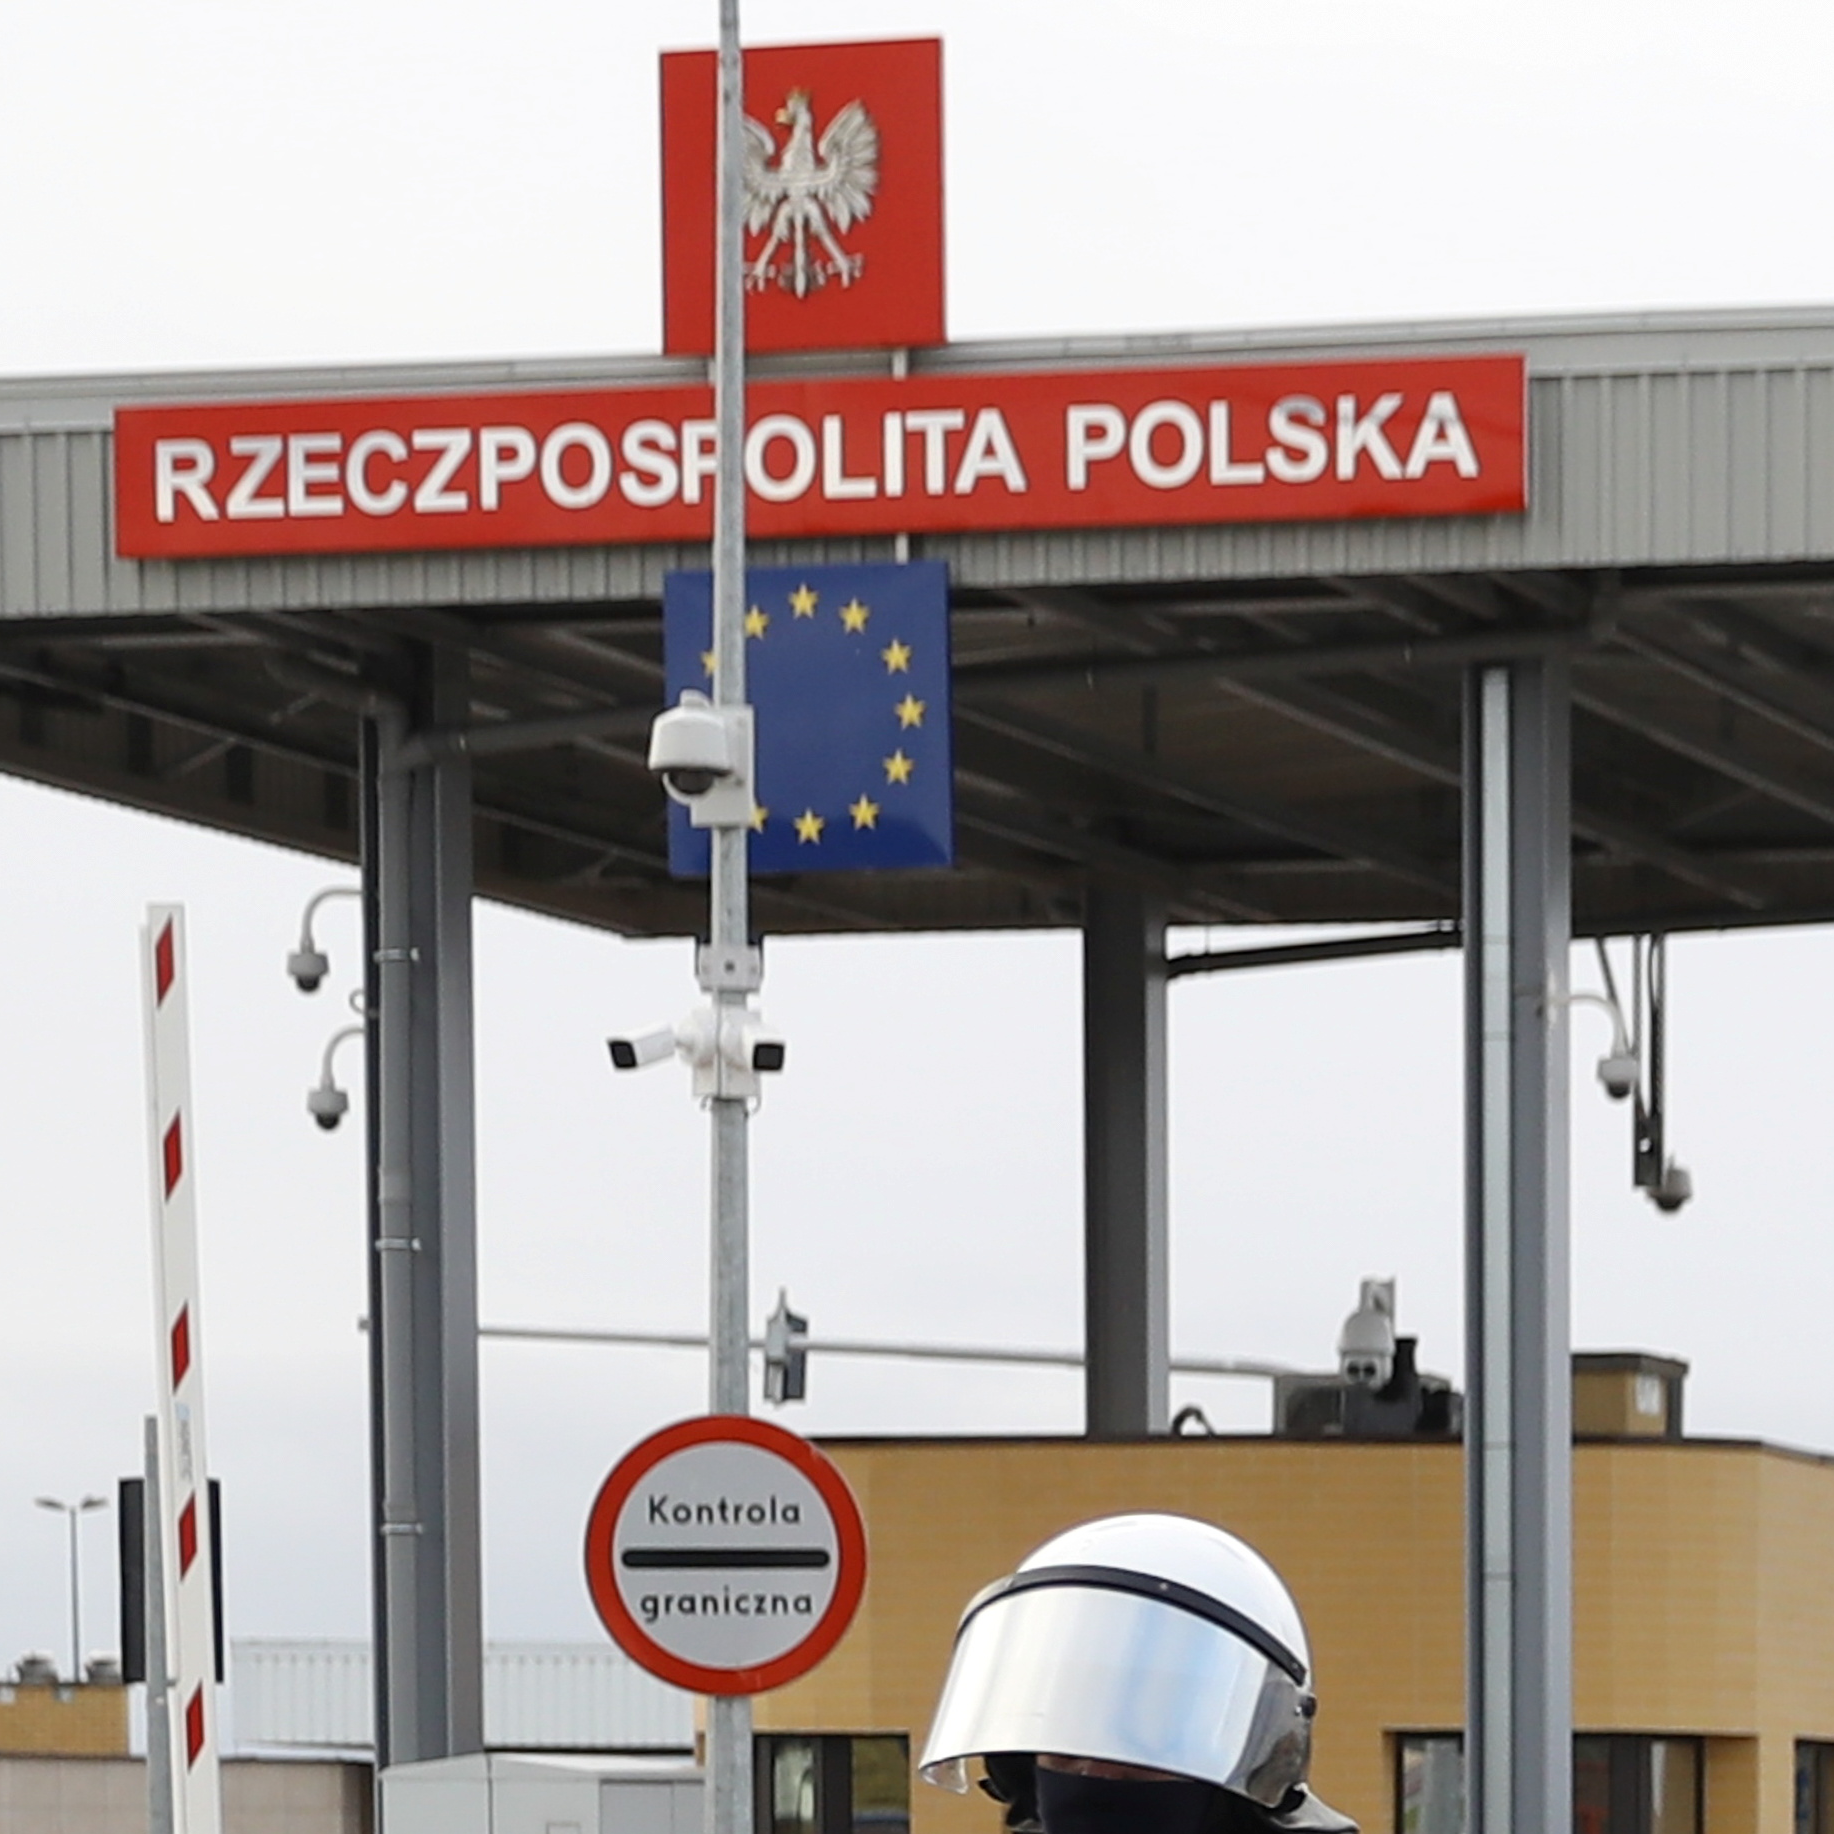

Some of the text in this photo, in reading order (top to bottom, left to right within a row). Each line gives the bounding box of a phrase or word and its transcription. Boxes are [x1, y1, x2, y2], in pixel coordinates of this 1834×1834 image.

[155, 390, 1480, 523] RZECZPOSPOLITA POLSKA
[648, 1495, 801, 1525] Kontrola
[639, 1584, 813, 1624] graniczna
